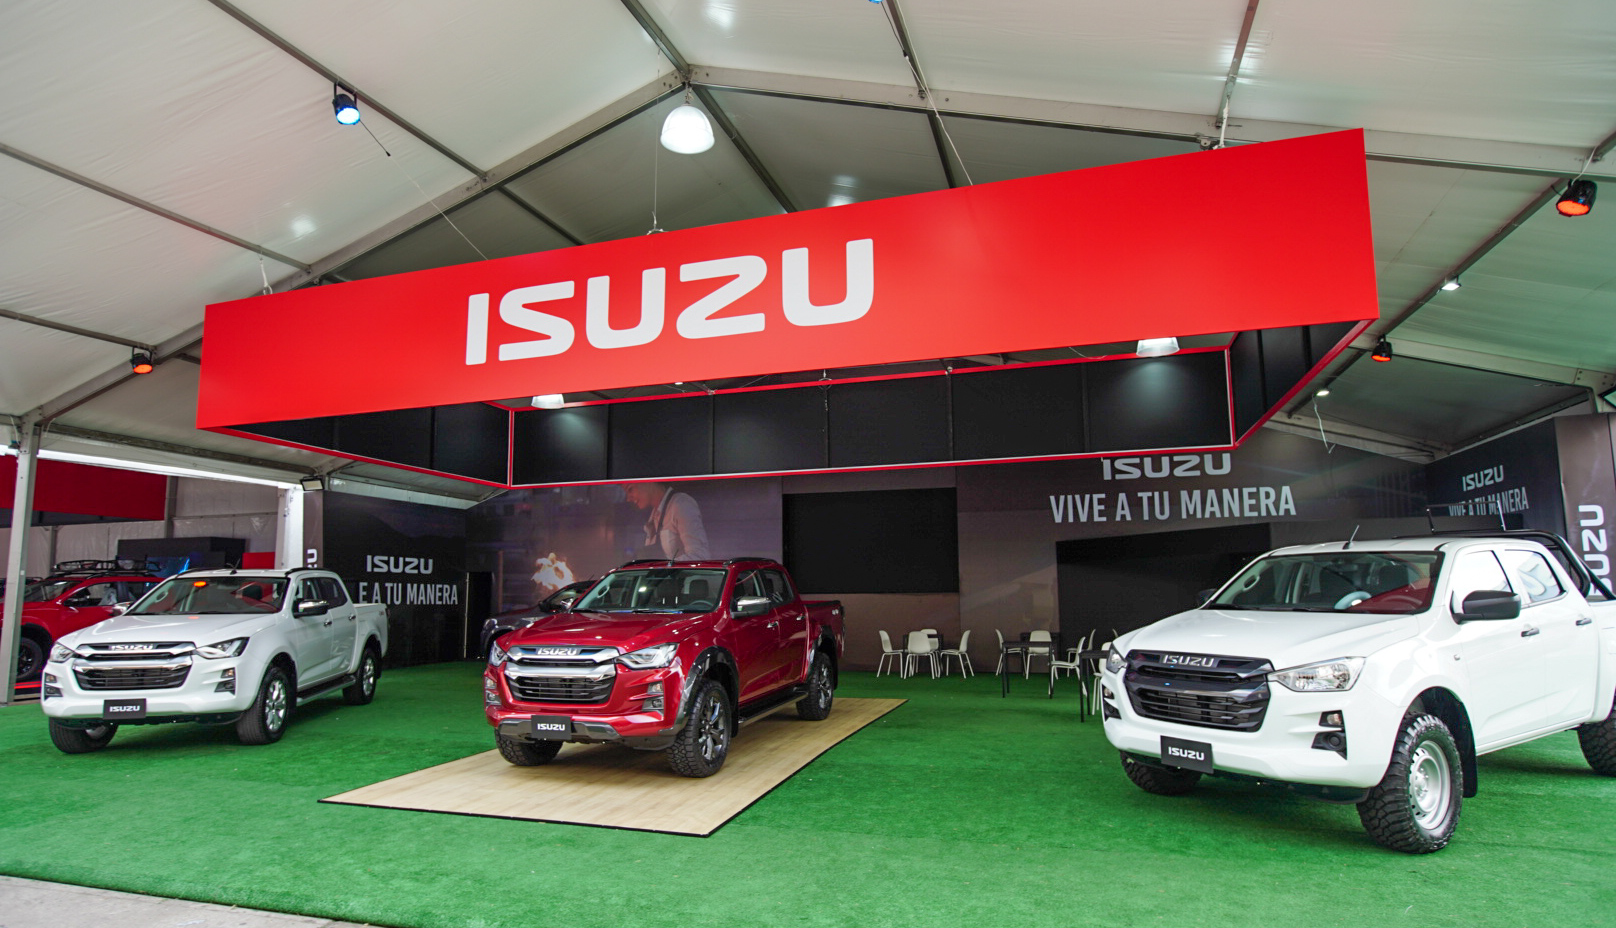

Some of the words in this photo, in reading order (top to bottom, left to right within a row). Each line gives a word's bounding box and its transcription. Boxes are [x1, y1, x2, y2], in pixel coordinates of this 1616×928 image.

[465, 238, 874, 365] ISUZU
[1102, 453, 1232, 480] ISUZU
[1462, 465, 1504, 491] ISUZU
[1050, 493, 1107, 523] VIVE
[1115, 492, 1132, 521] A
[1137, 491, 1170, 520] TU
[1180, 486, 1296, 519] MANERA
[1488, 486, 1529, 515] MANERA
[366, 555, 433, 574] ISUZU
[372, 582, 381, 603] A
[385, 582, 402, 605] TU
[406, 583, 458, 605] MANERA
[537, 648, 577, 656] ISUZU
[1163, 655, 1215, 667] ISUZU
[537, 723, 565, 731] ISUZU
[1168, 746, 1204, 760] ISUZU
